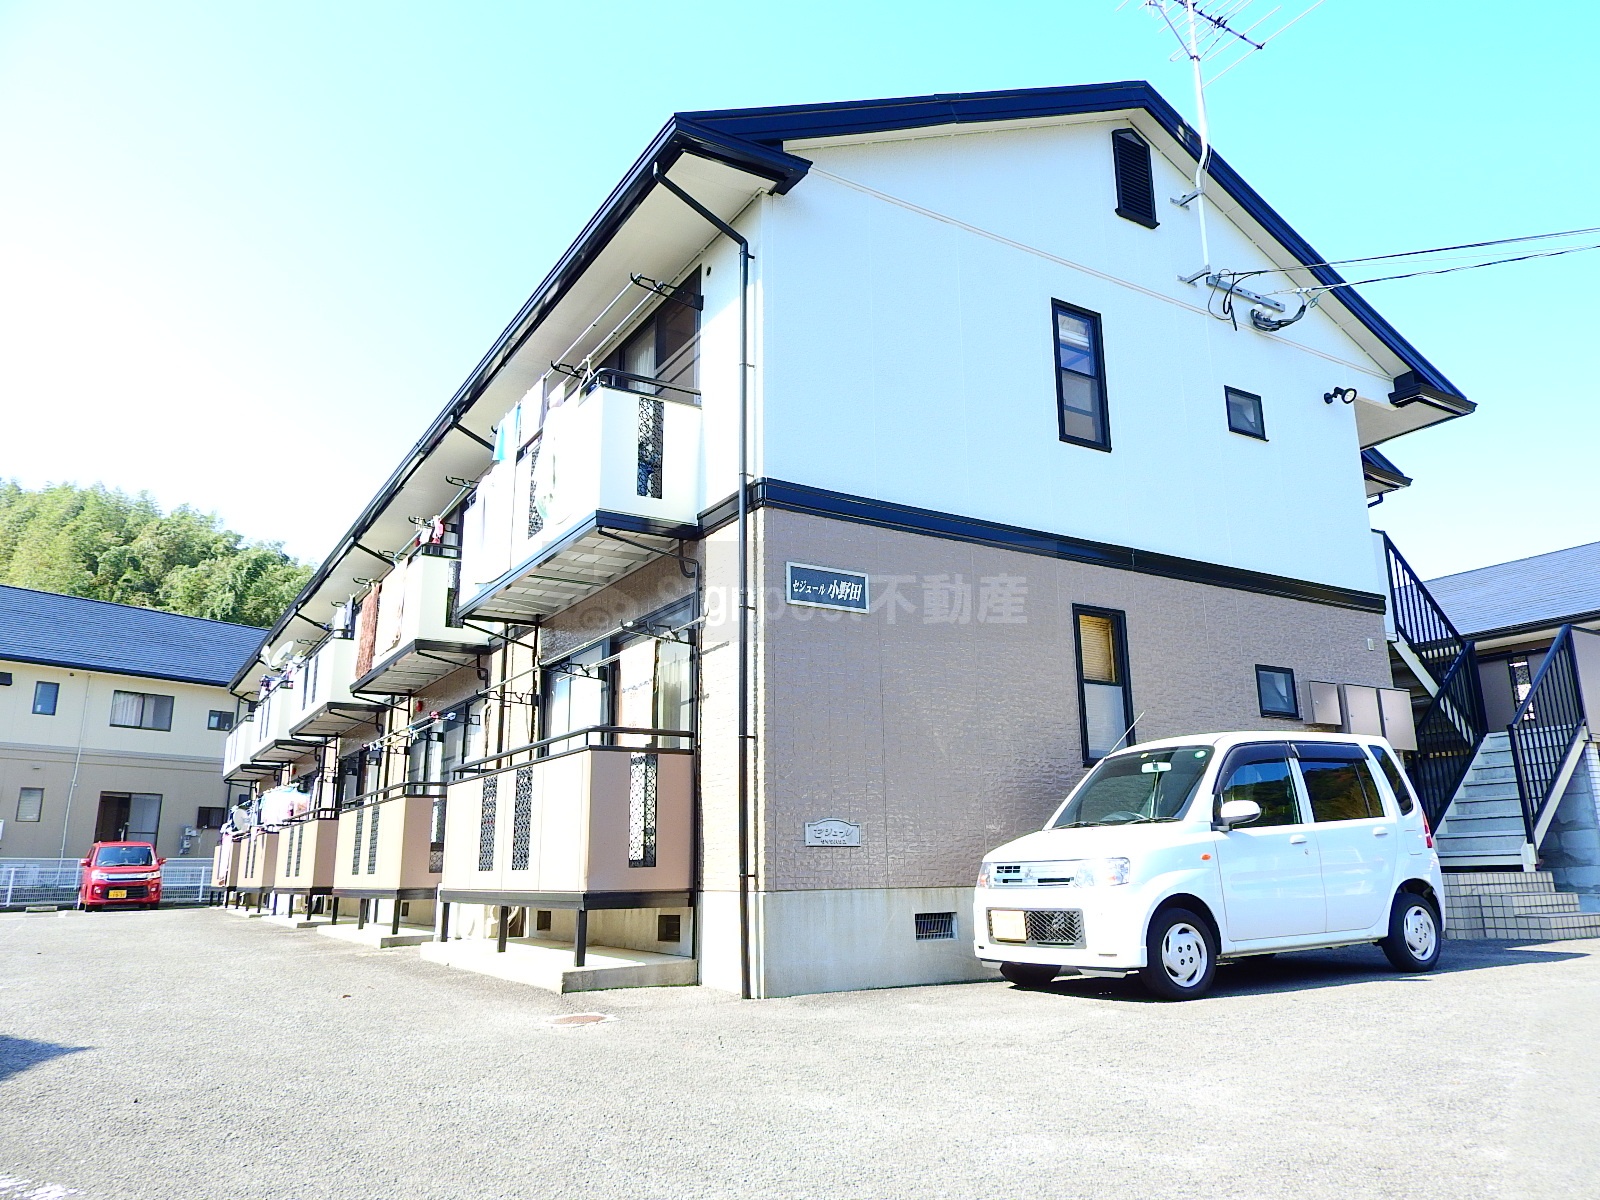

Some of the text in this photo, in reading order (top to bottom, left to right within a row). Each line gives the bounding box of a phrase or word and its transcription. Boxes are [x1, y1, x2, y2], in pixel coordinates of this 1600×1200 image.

[792, 579, 863, 602] セジュール 小野田
